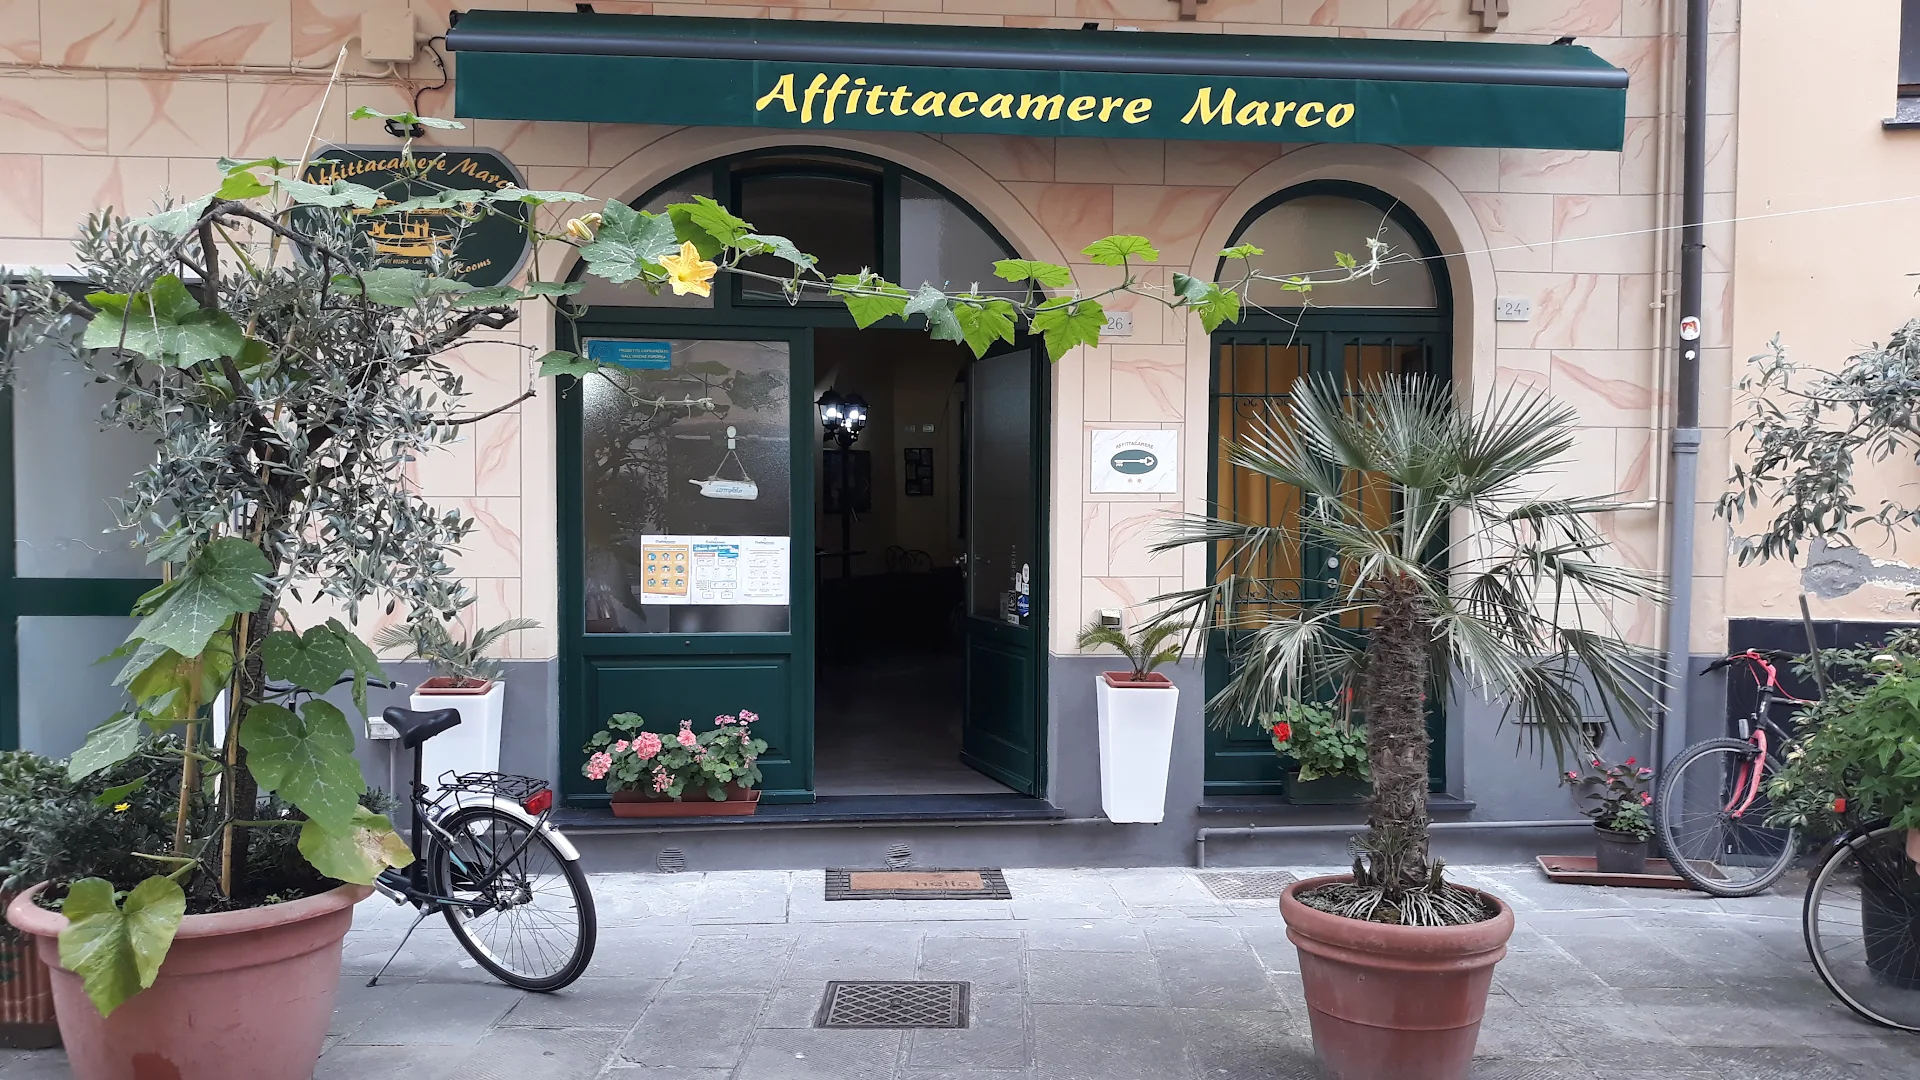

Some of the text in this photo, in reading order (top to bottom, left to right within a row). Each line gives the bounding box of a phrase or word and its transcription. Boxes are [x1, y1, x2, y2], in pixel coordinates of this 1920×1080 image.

[755, 72, 1355, 129] Affittacamere Marco
[447, 157, 509, 189] Marc
[1505, 302, 1522, 316] 24
[1107, 316, 1124, 330] 26
[1115, 441, 1154, 450] AFFITTACAMERE
